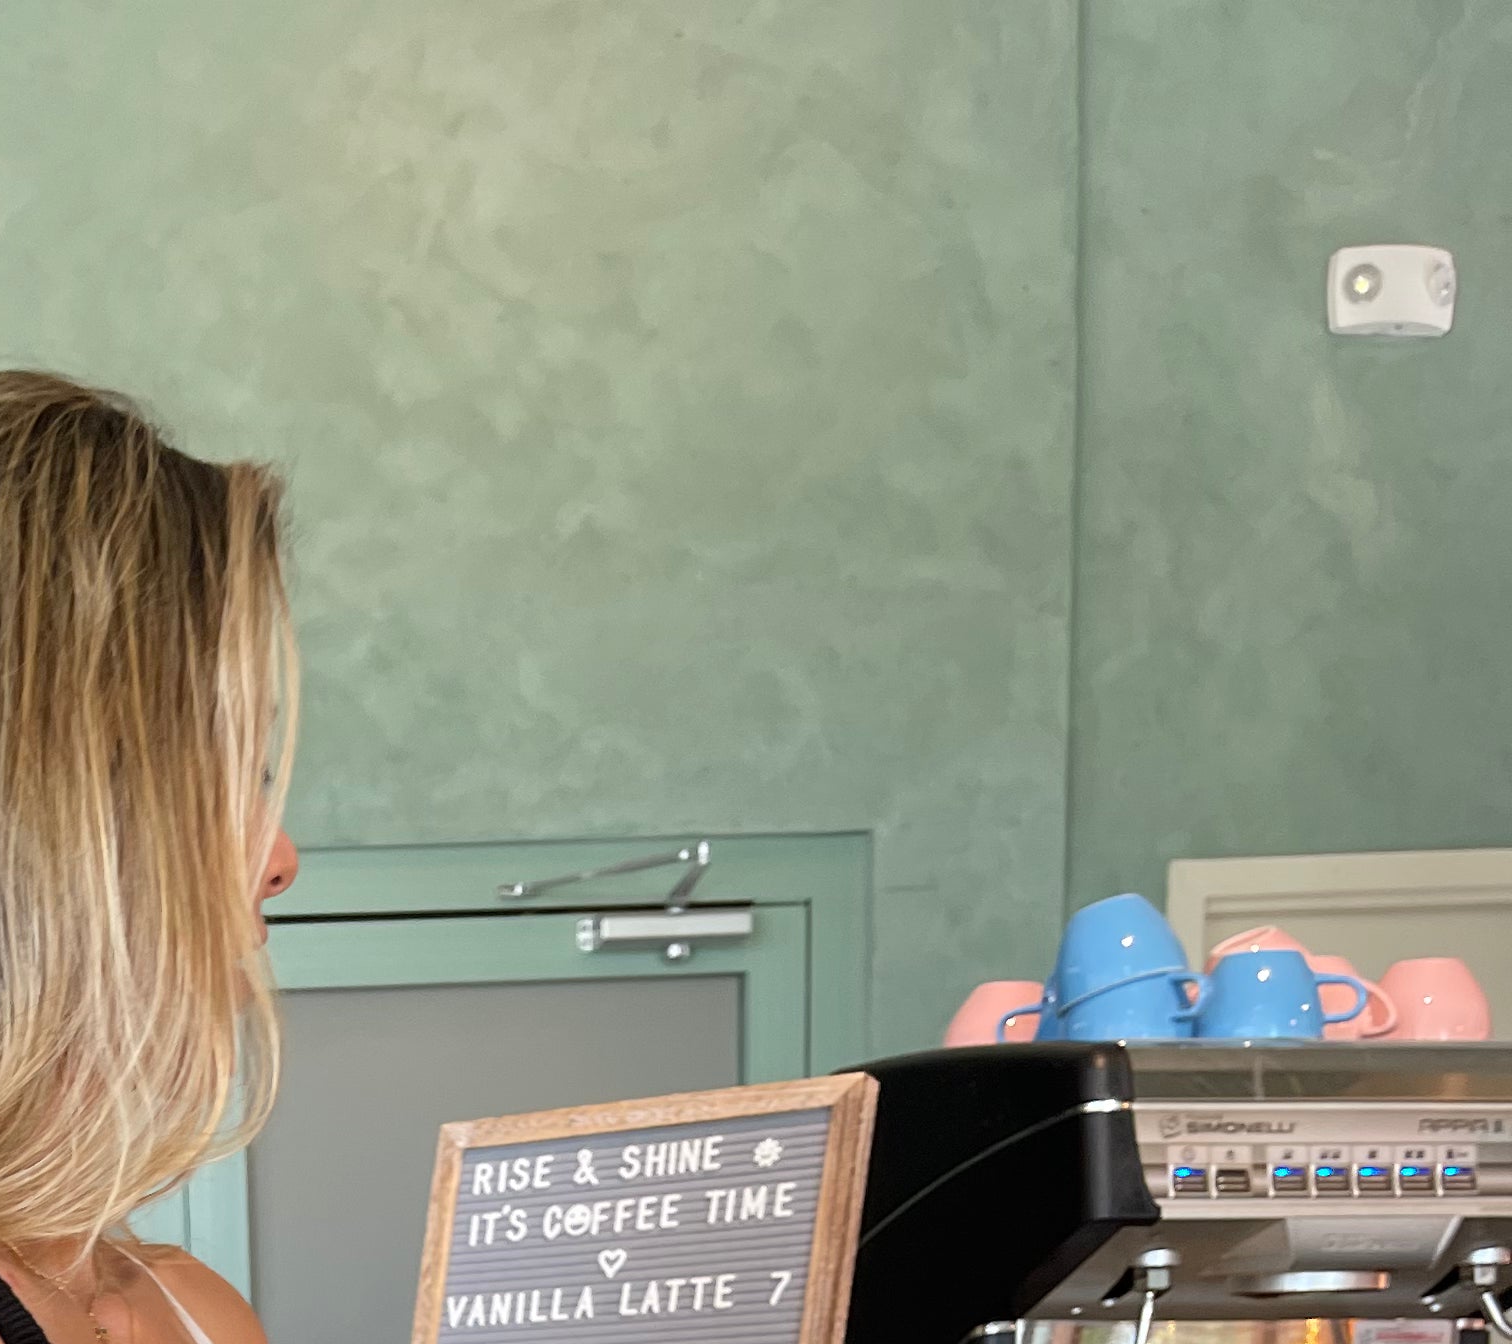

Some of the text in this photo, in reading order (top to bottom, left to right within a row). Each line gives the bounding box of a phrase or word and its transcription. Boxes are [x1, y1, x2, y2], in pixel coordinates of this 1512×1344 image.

[470, 1134, 726, 1197] RISE & SHINE
[467, 1203, 530, 1249] IT'S
[703, 1180, 800, 1226] TIME
[445, 1269, 794, 1330] VANILLA LATTE 7
